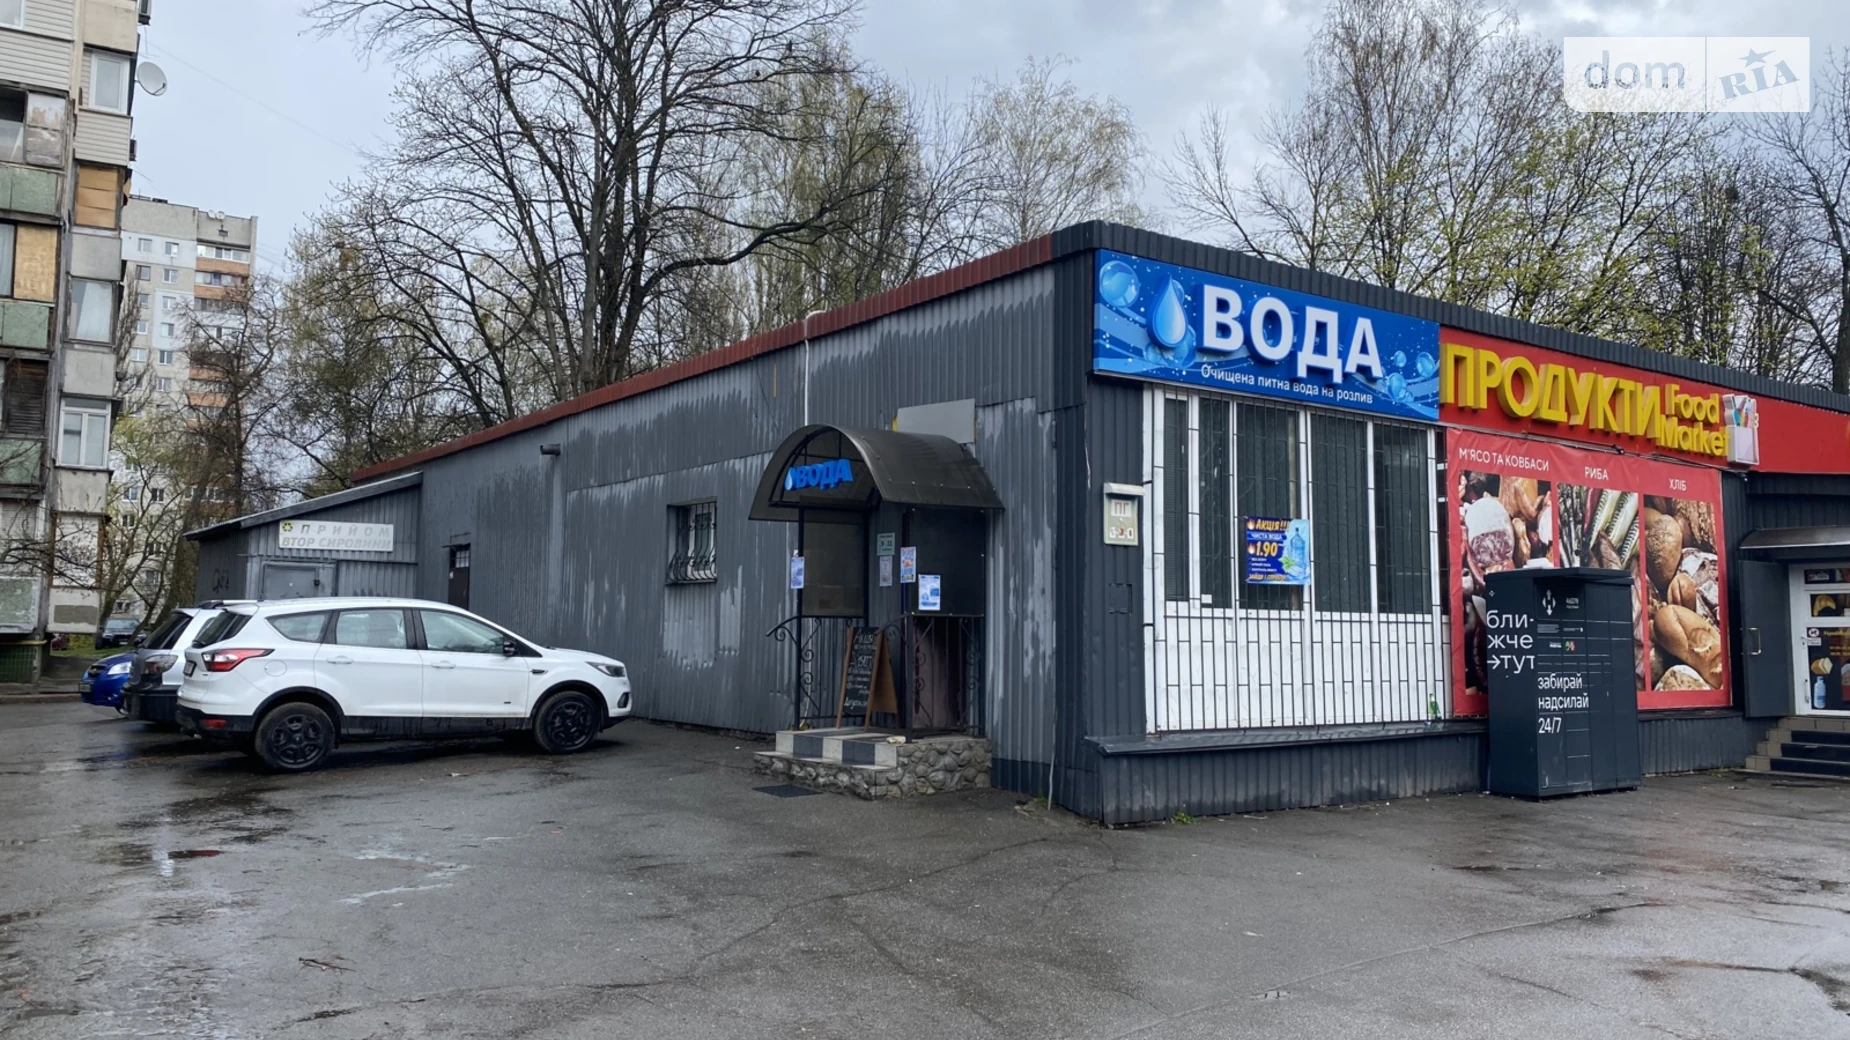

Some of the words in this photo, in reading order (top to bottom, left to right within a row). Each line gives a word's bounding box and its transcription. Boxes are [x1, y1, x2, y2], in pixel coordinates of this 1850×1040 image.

[1202, 284, 1384, 384] ВОДА
[1201, 364, 1255, 385] Очищена
[1257, 375, 1290, 391] питна
[1293, 382, 1319, 396] вода
[1321, 386, 1334, 398] на
[1336, 389, 1373, 405] розлив
[1440, 342, 1661, 440] ПРОДУКТИ
[1665, 383, 1720, 424] Food
[1659, 413, 1729, 458] Market
[1458, 447, 1490, 464] М'ЯСО
[1491, 452, 1505, 466] ТА
[1505, 456, 1550, 473] КОВБАСИ
[795, 458, 853, 489] ВОДА
[1584, 466, 1609, 481] РИБА
[1668, 478, 1687, 492] ХЛІБ
[282, 537, 315, 546] ВТОР
[318, 537, 392, 550] СИРОВИНИ
[1256, 541, 1278, 557] 1.90
[1486, 609, 1534, 629] бли-
[1487, 634, 1533, 649] жче
[1501, 654, 1535, 674] тут
[1538, 673, 1583, 692] забирай
[1538, 693, 1589, 711] надсилай
[1538, 716, 1562, 734] 24/7
